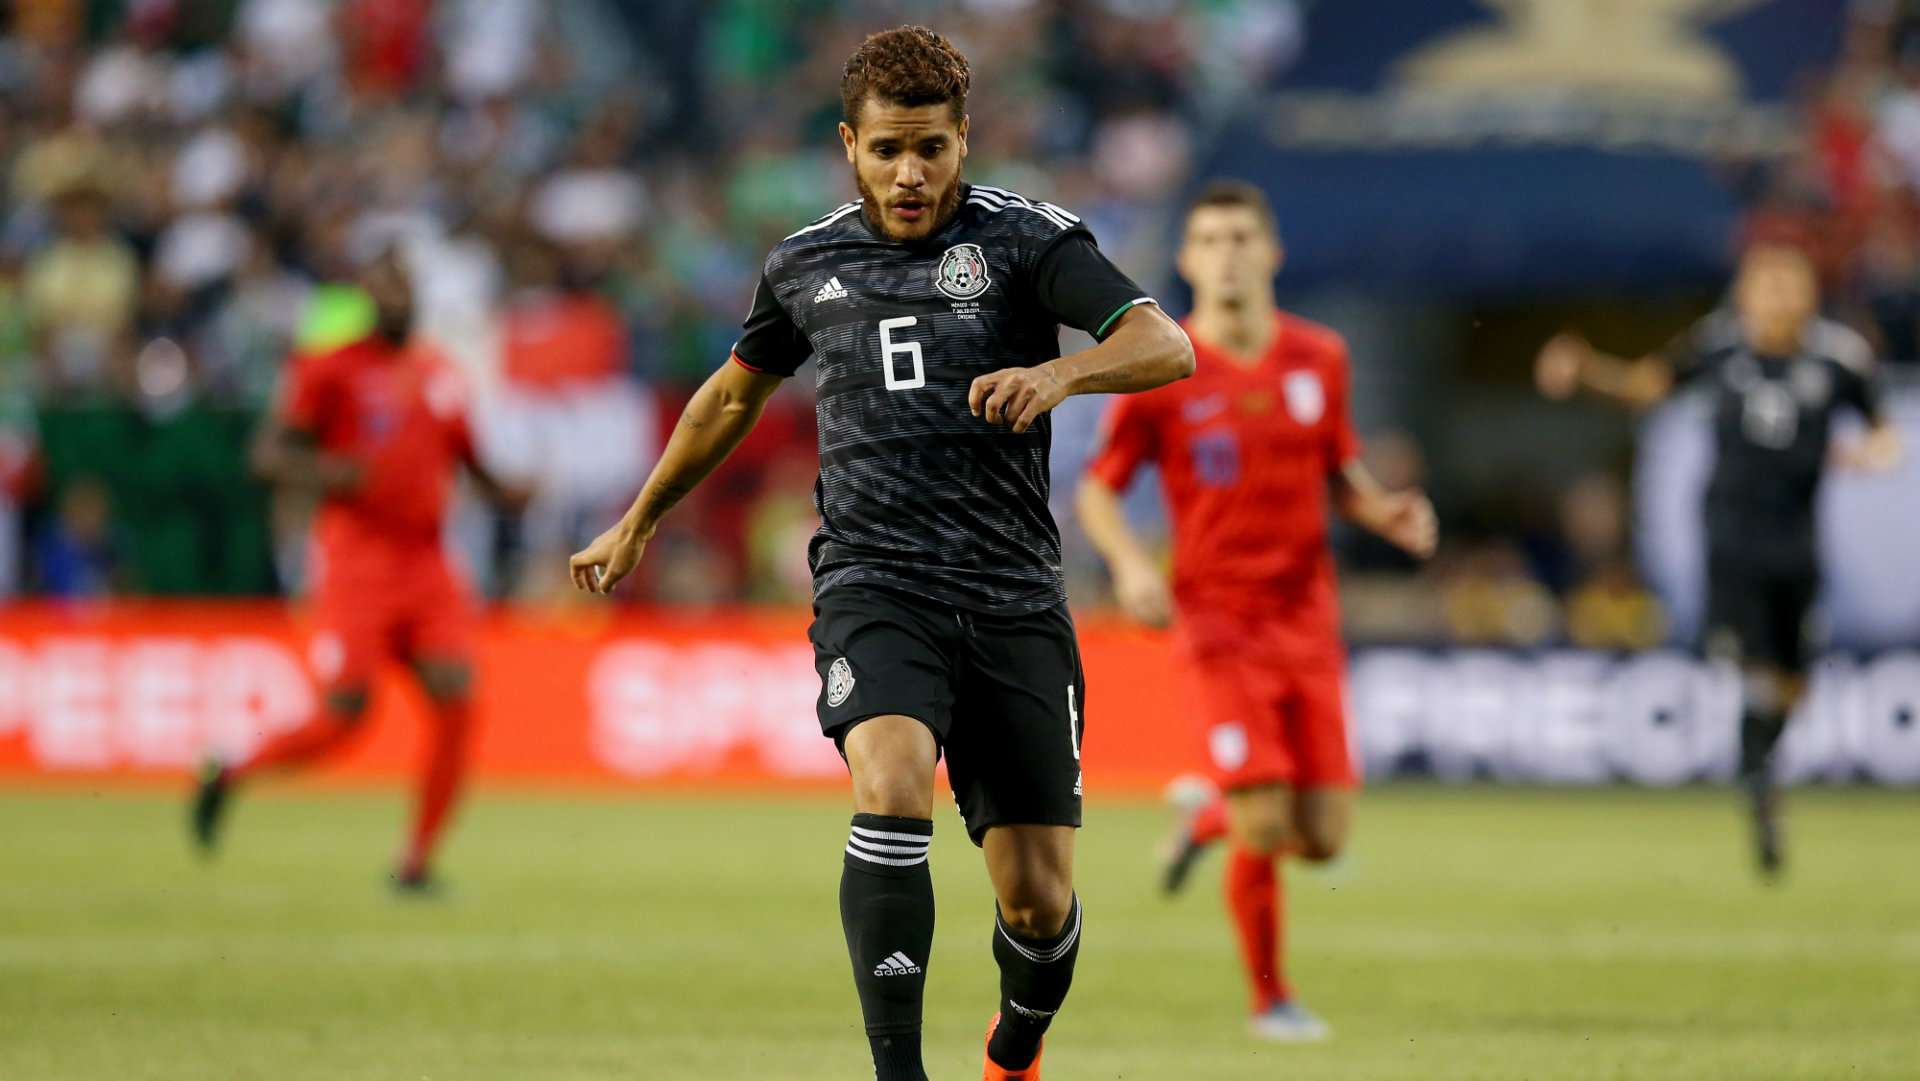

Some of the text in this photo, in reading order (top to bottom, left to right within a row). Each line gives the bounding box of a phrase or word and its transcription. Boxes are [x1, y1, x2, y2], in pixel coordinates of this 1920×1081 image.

[813, 289, 848, 303] adidas
[879, 316, 925, 391] 6
[873, 966, 921, 977] adidas
